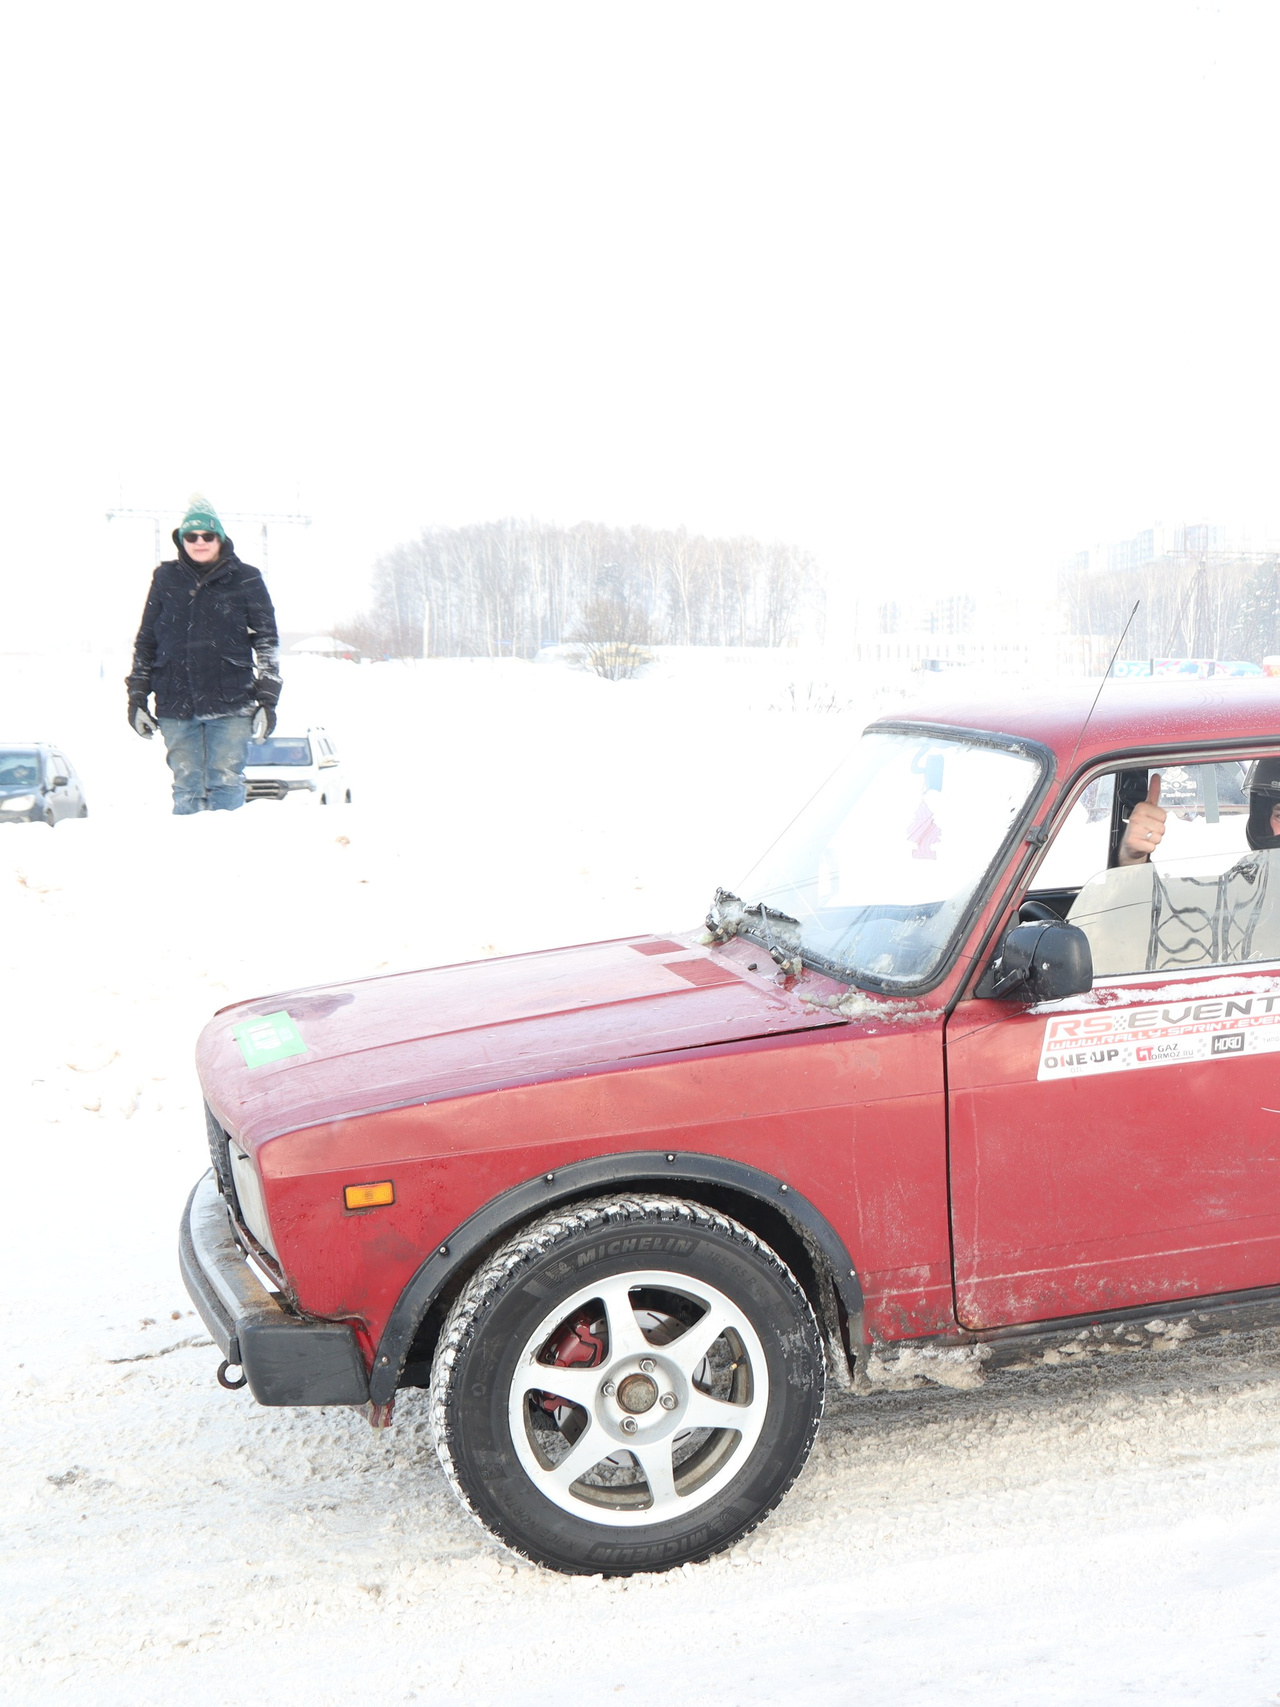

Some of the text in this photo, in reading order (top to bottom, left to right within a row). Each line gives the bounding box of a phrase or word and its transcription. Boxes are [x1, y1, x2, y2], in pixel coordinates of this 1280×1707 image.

[1049, 1015, 1114, 1039] RS
[1158, 1043, 1179, 1053] GAZ
[577, 1236, 694, 1264] MICHELIN
[747, 1275, 757, 1287] R
[501, 1493, 540, 1535] NORTH
[588, 1529, 709, 1563] MICHELIN
